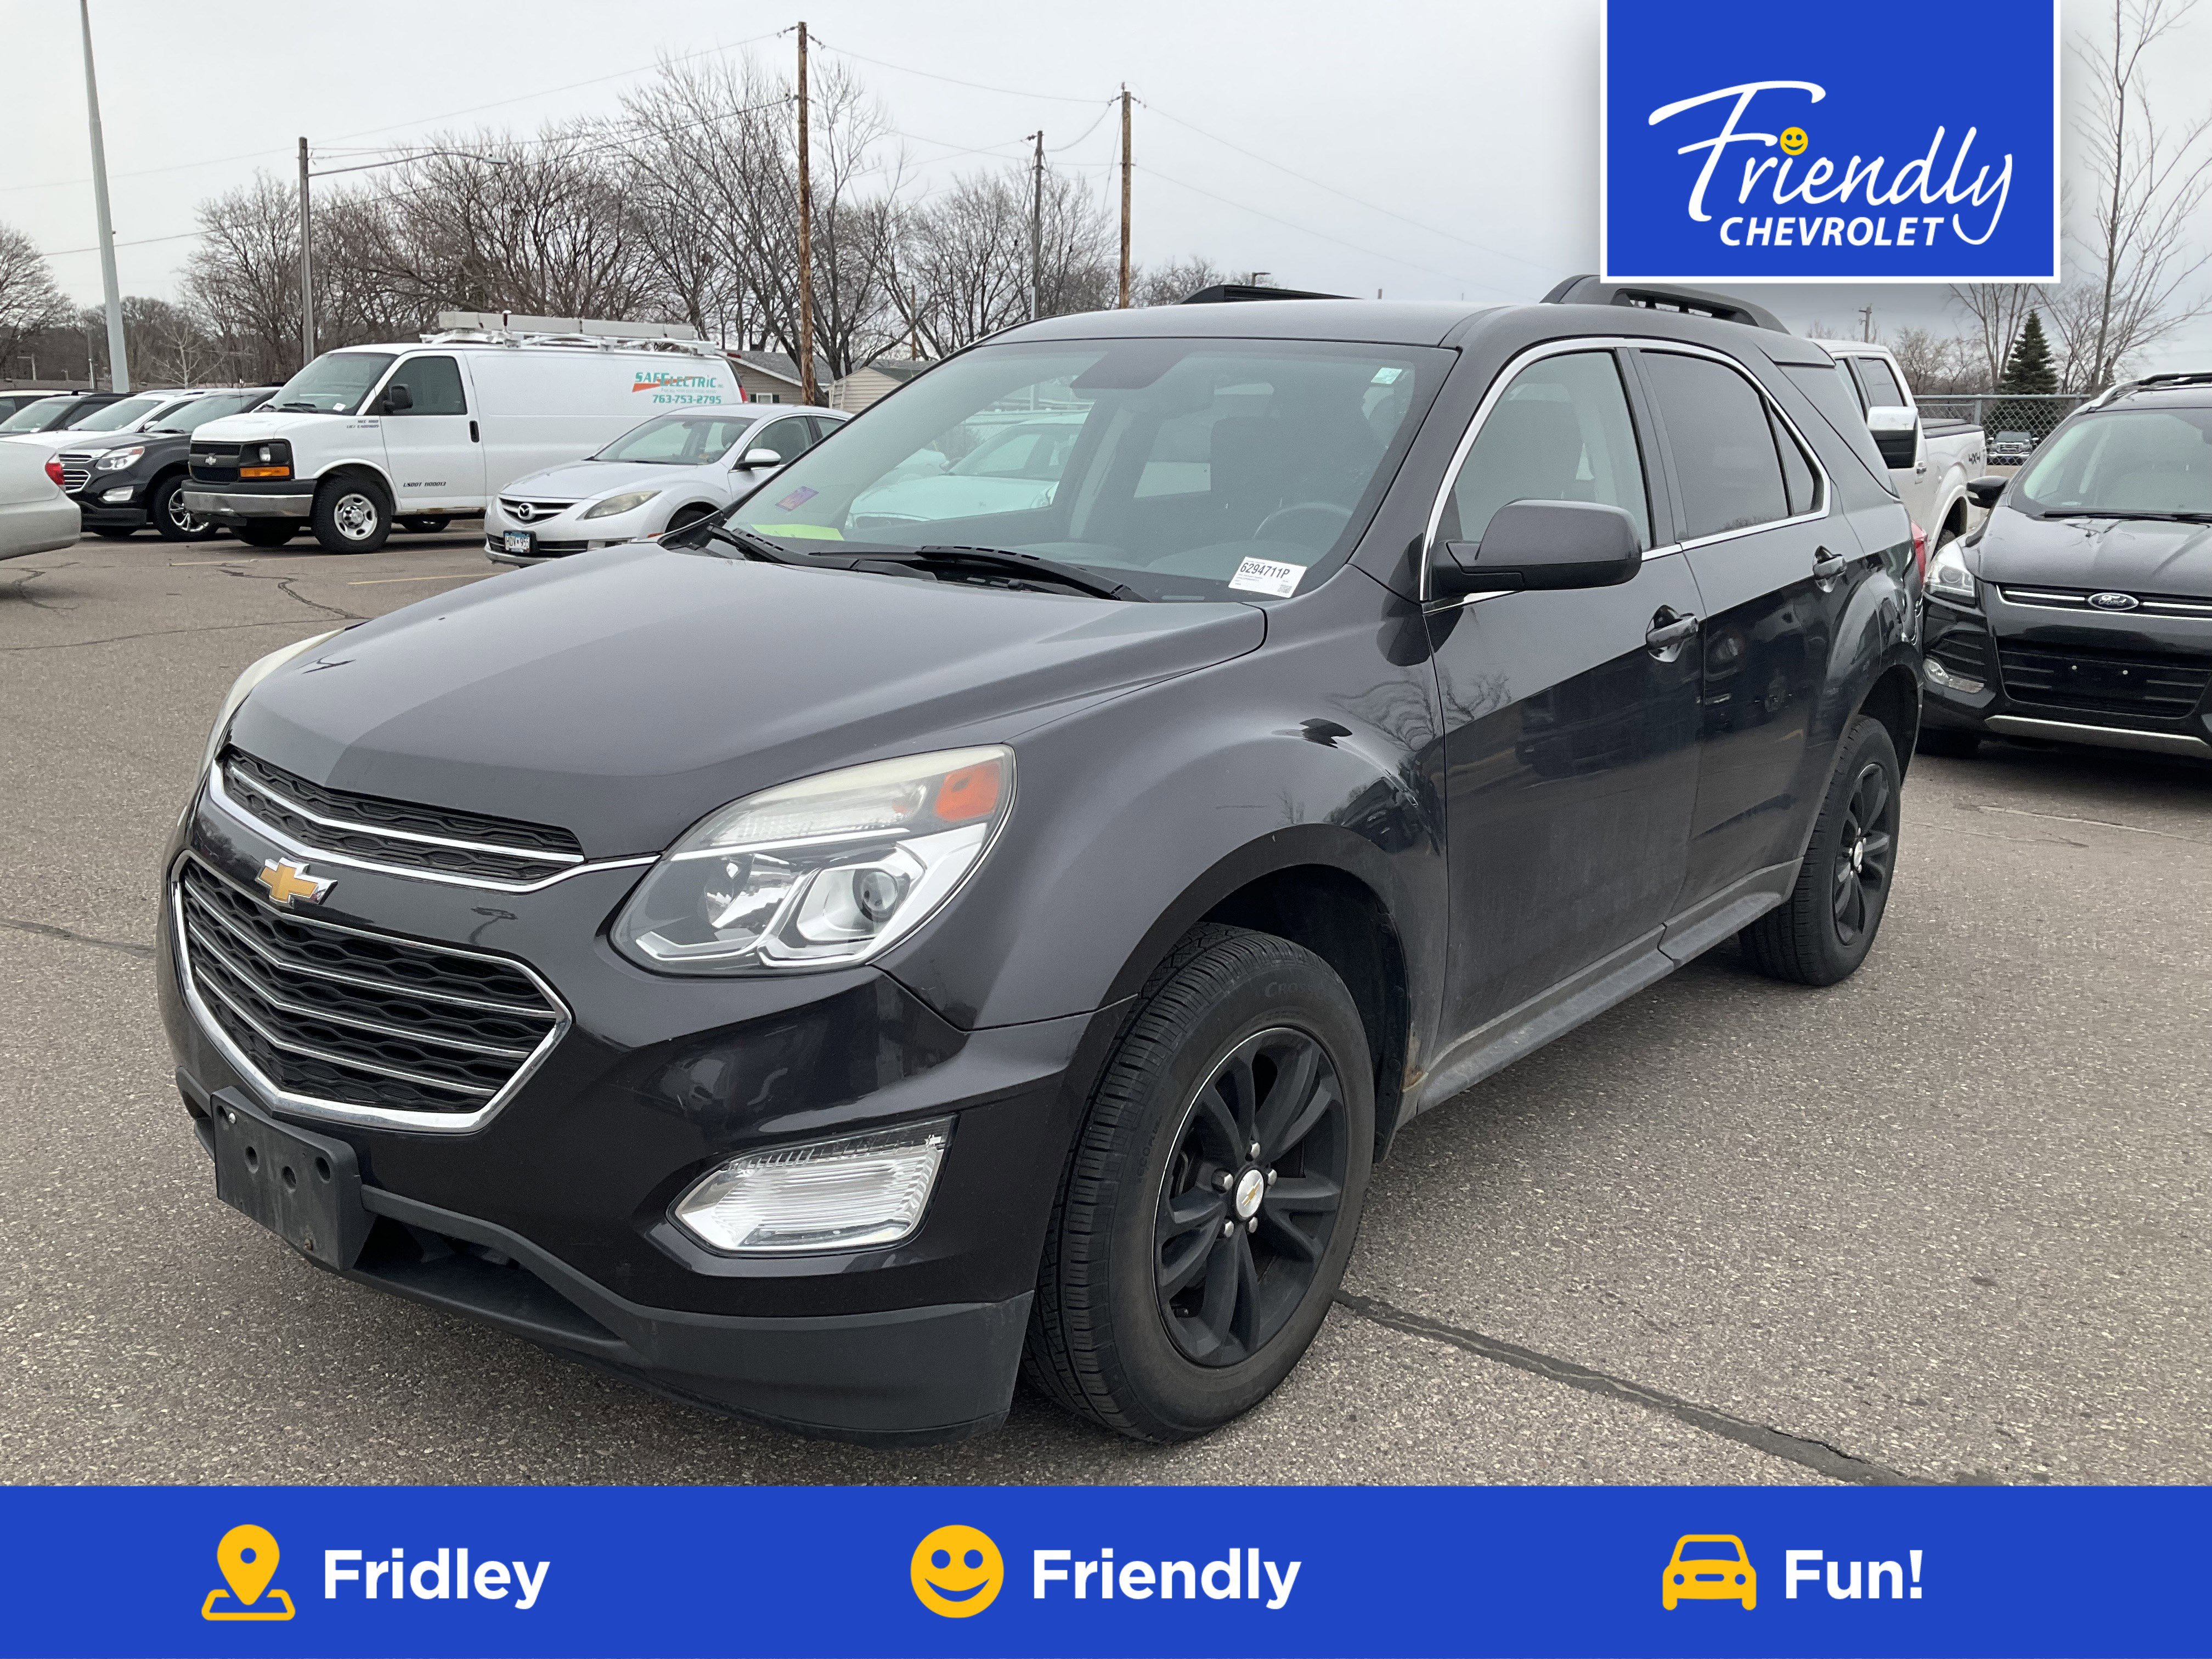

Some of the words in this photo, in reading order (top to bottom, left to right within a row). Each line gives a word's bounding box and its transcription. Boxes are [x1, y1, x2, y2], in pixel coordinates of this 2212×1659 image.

[652, 394, 721, 404] 763-753-2795
[1240, 562, 1290, 579] 6294711P
[2098, 595, 2127, 606] Ford
